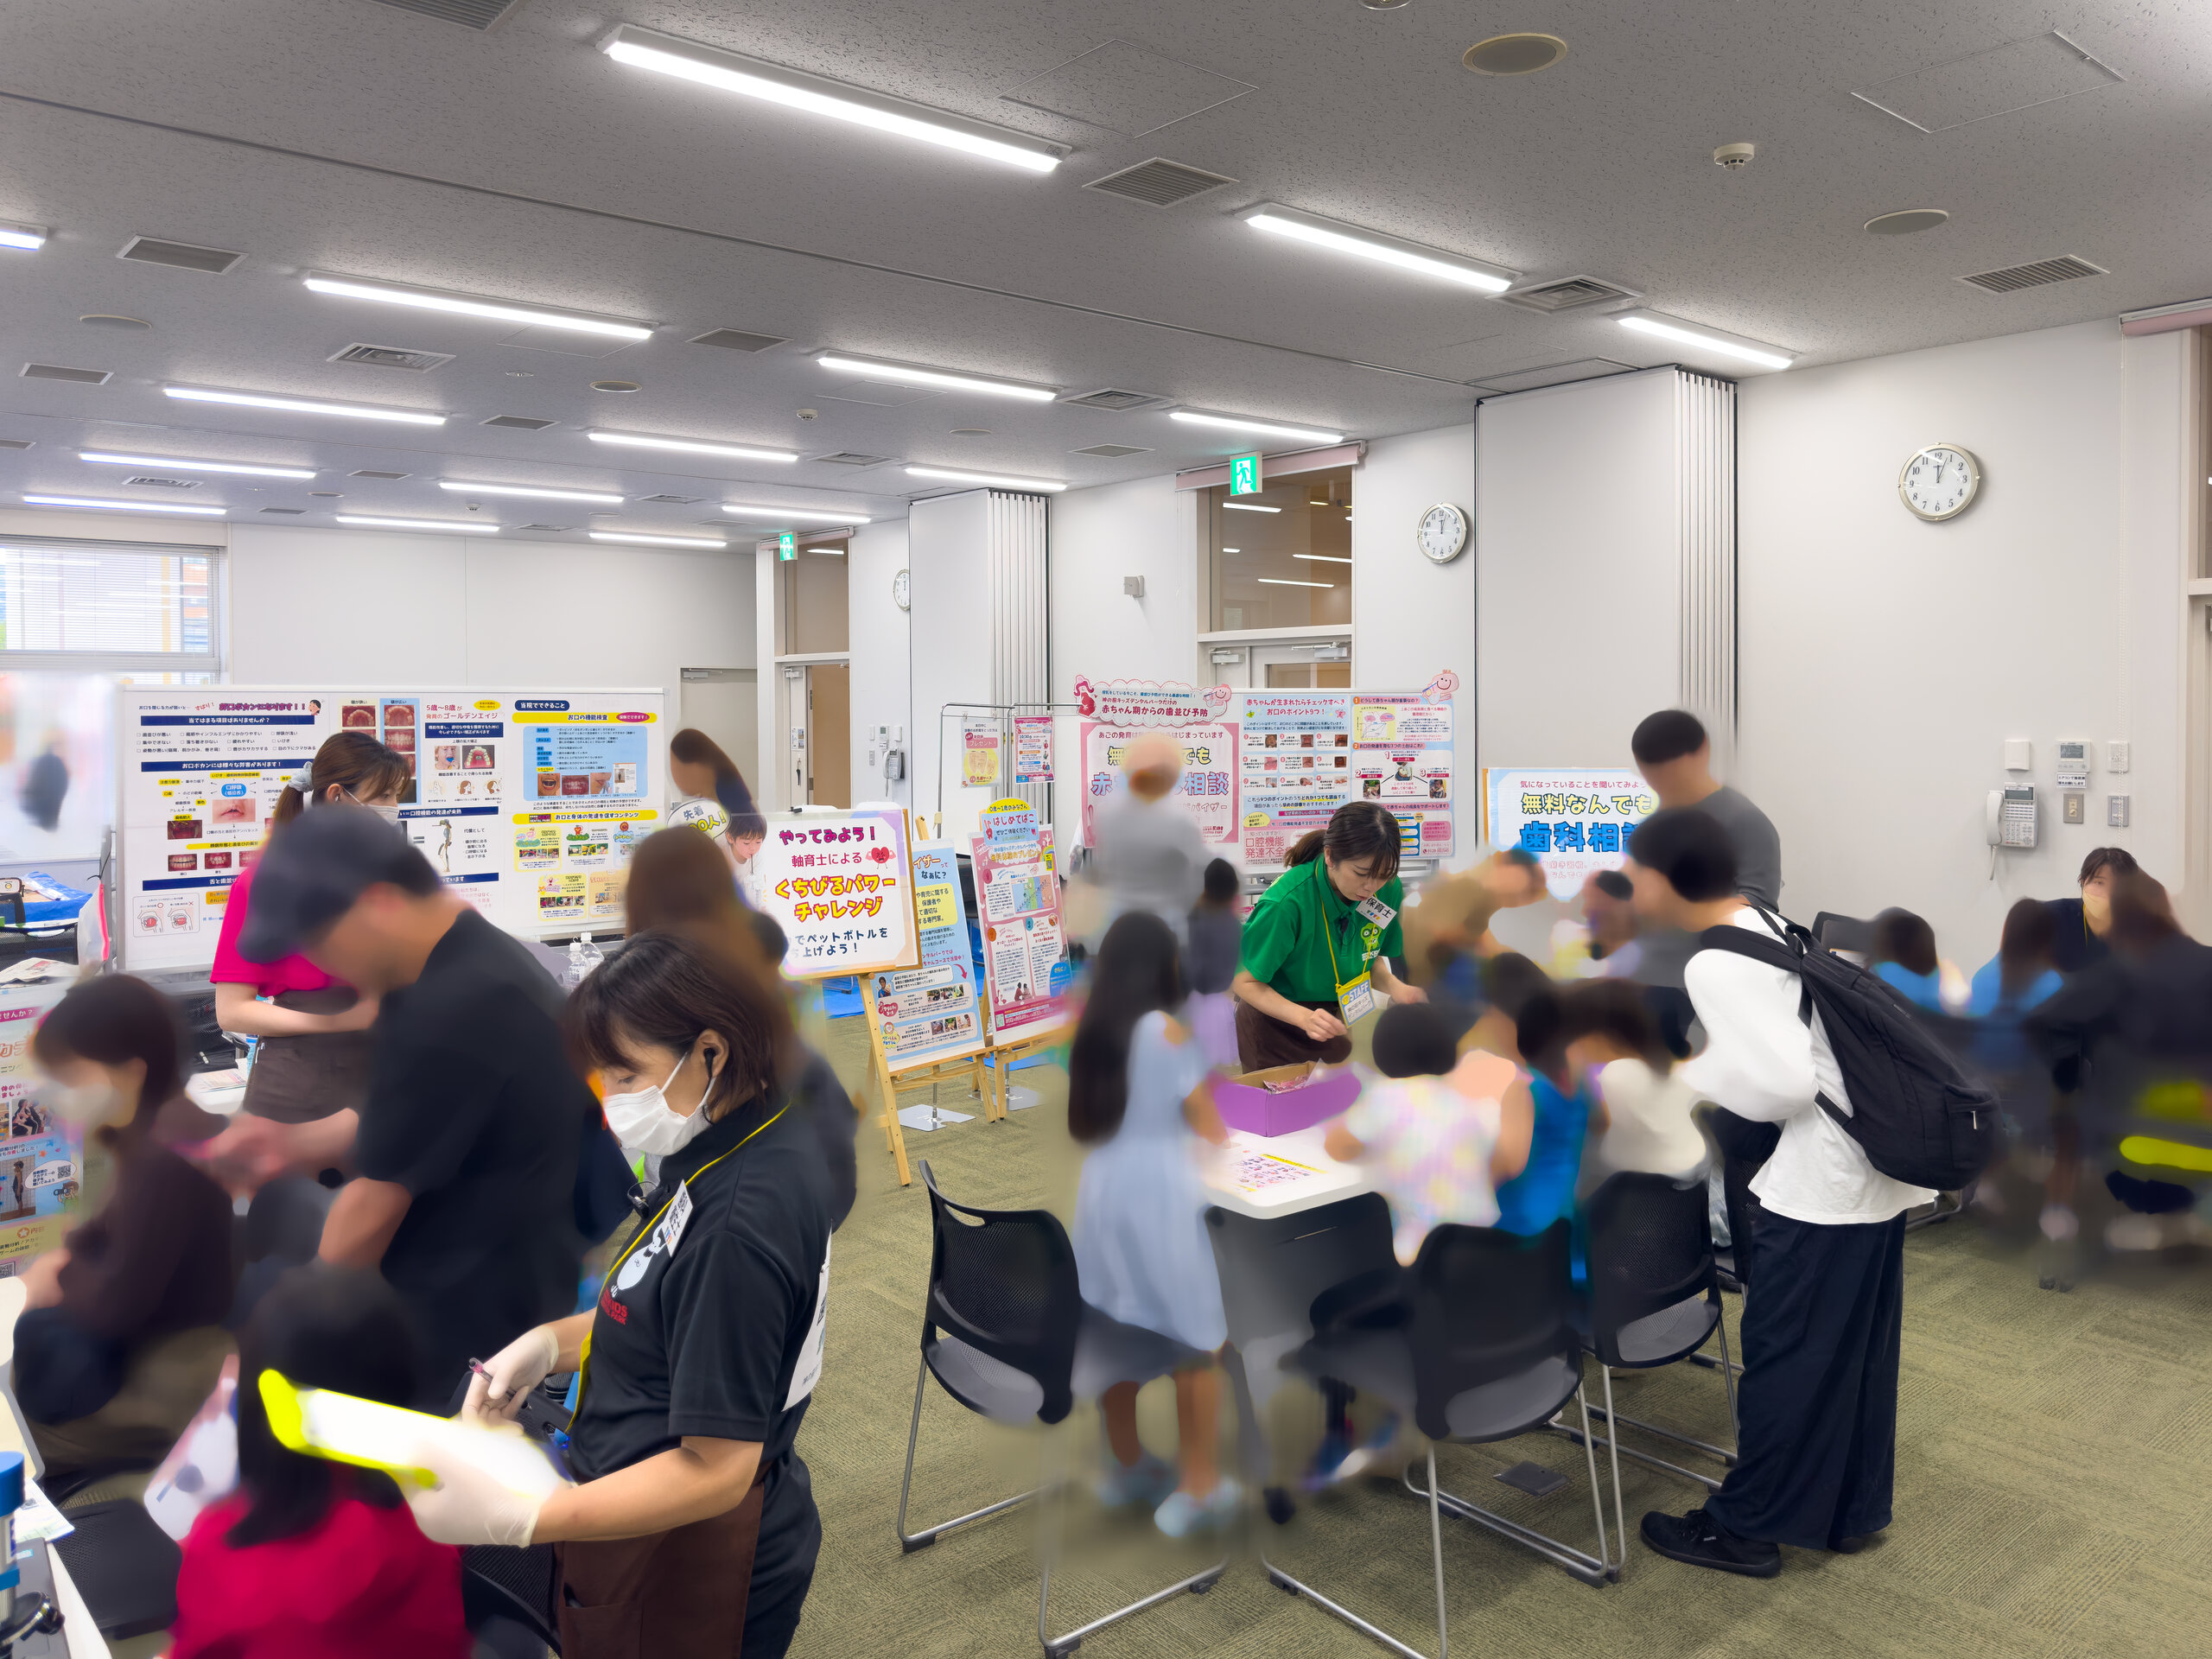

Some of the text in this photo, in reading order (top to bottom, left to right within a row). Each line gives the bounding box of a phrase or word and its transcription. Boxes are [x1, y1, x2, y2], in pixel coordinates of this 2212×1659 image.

[1949, 454, 1953, 462] 1
[1912, 467, 1920, 475] 10
[1909, 480, 1915, 488] 9
[1962, 474, 1967, 483] 3
[1957, 488, 1963, 497] 4
[1935, 503, 1940, 512] 6
[1948, 499, 1954, 507] 5
[1102, 704, 1208, 717] 赤ちゃん期からの歯並び予防
[1185, 772, 1229, 796] 相談
[1521, 792, 1655, 815] 無料なんでも
[683, 805, 704, 821] 先着
[993, 813, 1034, 826] はじめてばこ
[779, 826, 875, 845] やってみよう！
[1245, 836, 1285, 848] 口腔機能
[1245, 847, 1289, 859] 発達不全
[921, 870, 947, 880] なぁに？
[775, 874, 896, 899] くちびるパワー
[794, 896, 883, 923] チャレンジ
[1365, 897, 1392, 918] 保育士
[1349, 981, 1369, 1001] STAFF
[0, 1009, 33, 1020] せんか？
